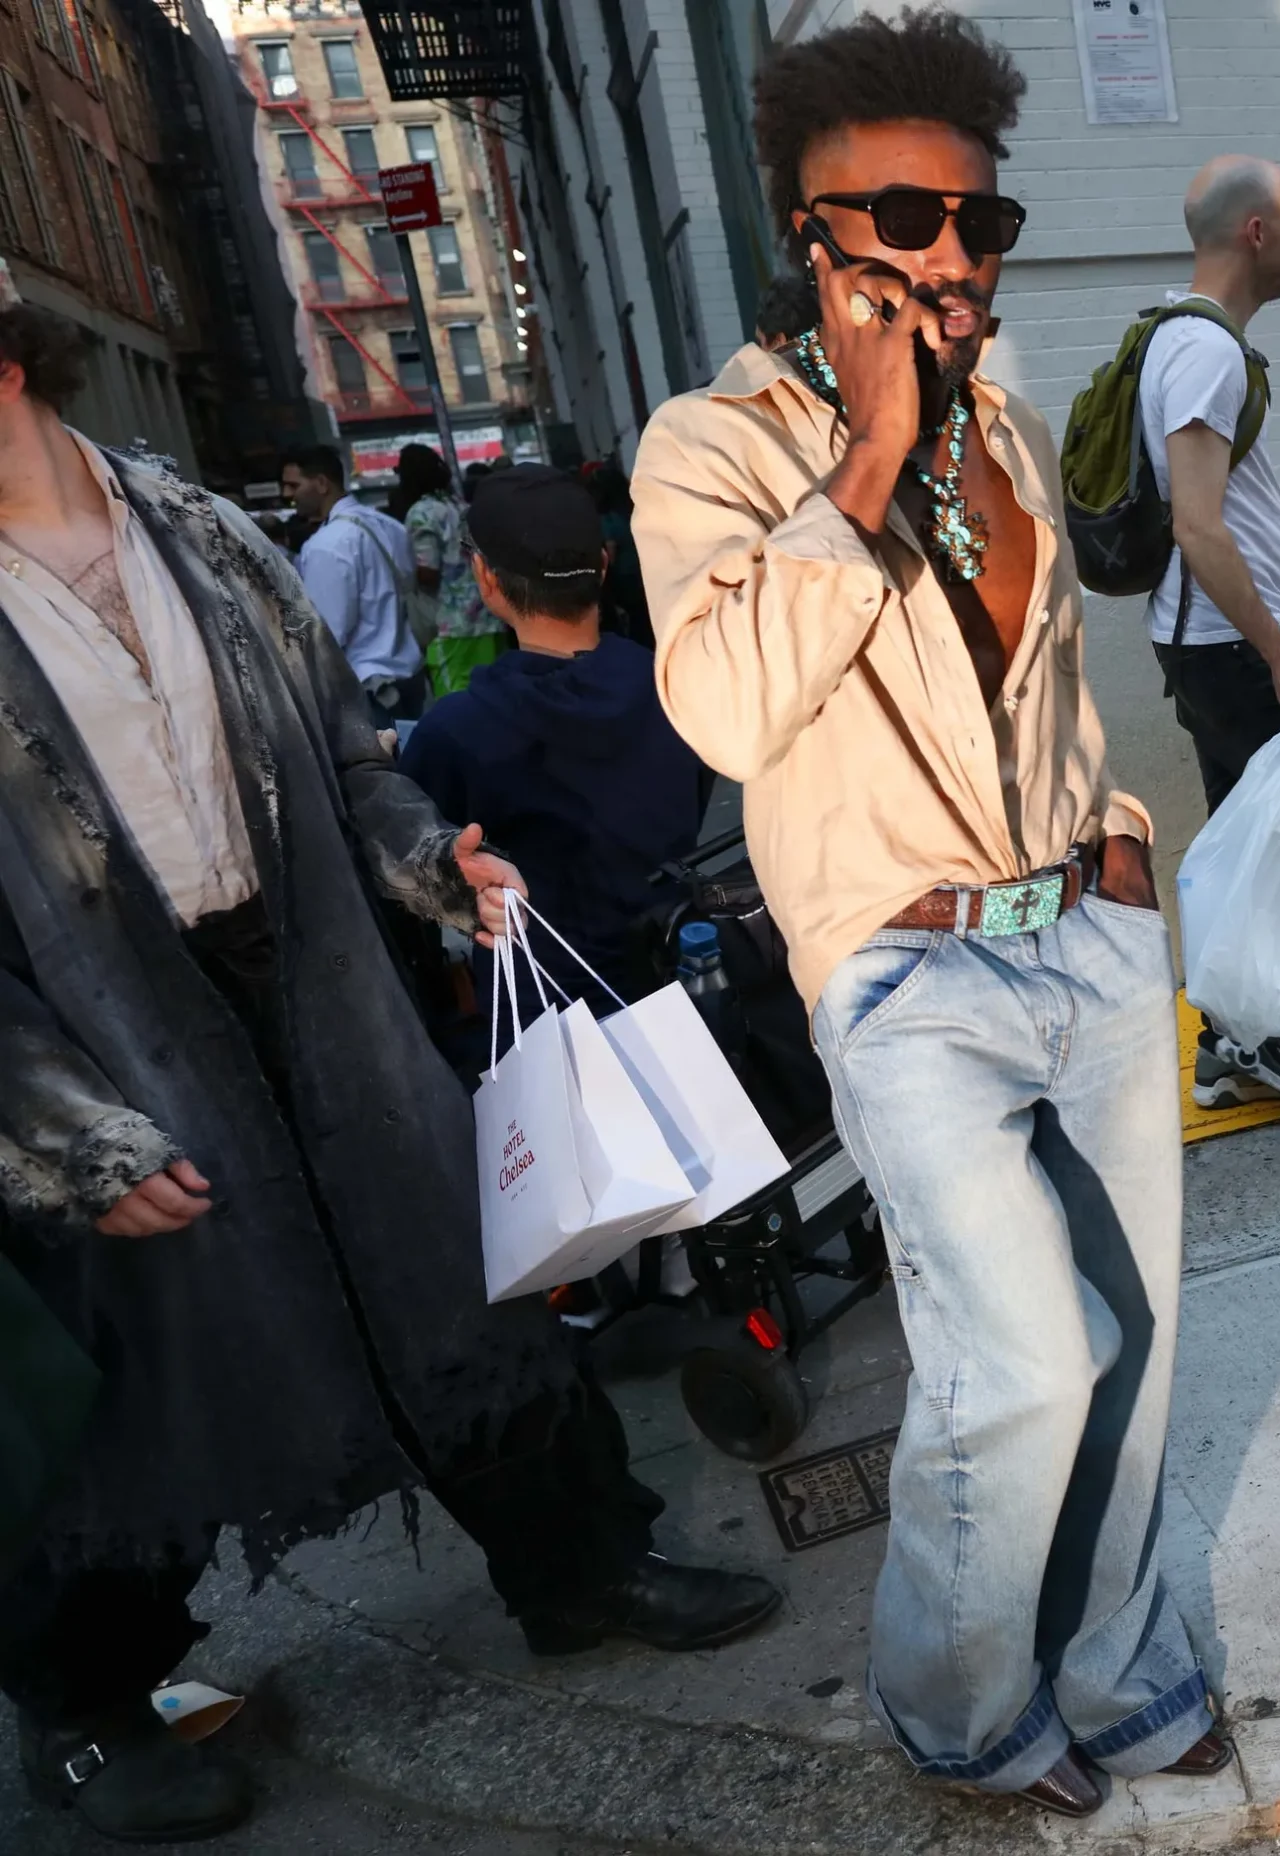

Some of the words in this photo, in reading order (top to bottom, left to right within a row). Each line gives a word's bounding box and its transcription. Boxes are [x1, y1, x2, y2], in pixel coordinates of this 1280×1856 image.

[1093, 0, 1111, 8] NYC
[392, 171, 426, 187] STANDING
[507, 1119, 517, 1135] THE
[503, 1129, 525, 1160] HOTEL
[499, 1149, 535, 1192] Chelsea
[836, 1460, 870, 1514] PENALTY
